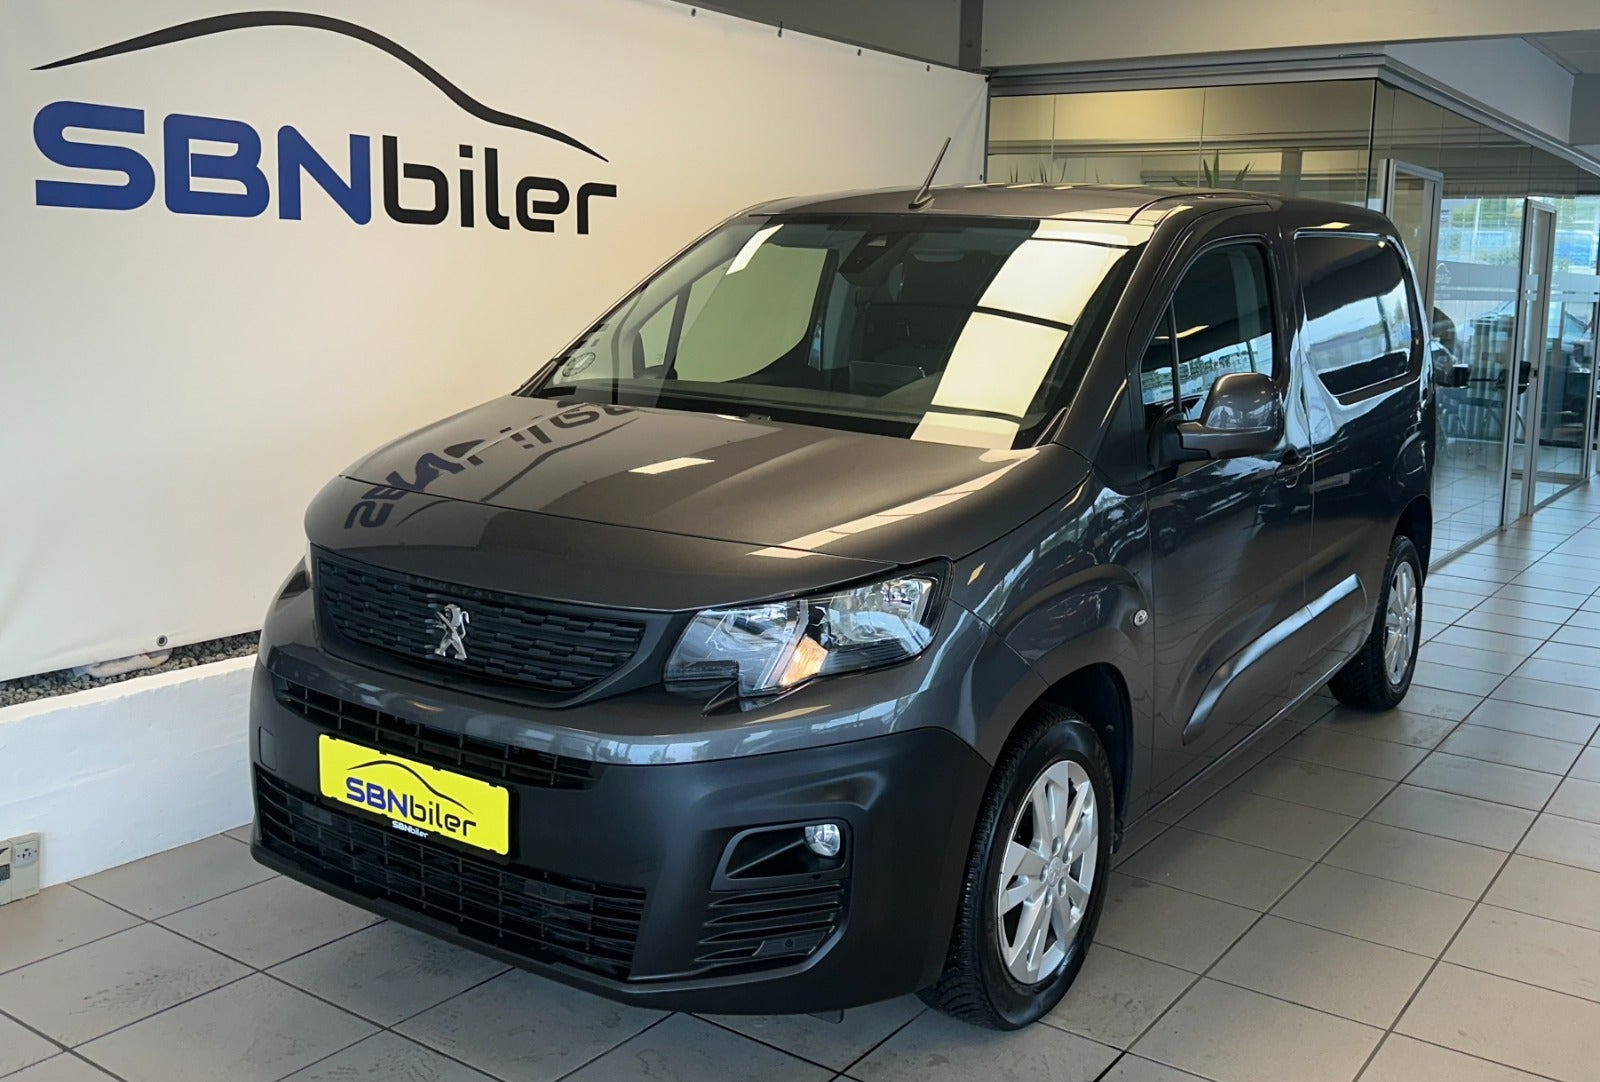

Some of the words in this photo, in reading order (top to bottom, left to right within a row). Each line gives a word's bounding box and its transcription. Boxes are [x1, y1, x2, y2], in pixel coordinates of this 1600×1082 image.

[33, 101, 617, 235] SBNbiler
[346, 777, 477, 836] SBNbiler
[392, 820, 429, 838] SBNbiler
